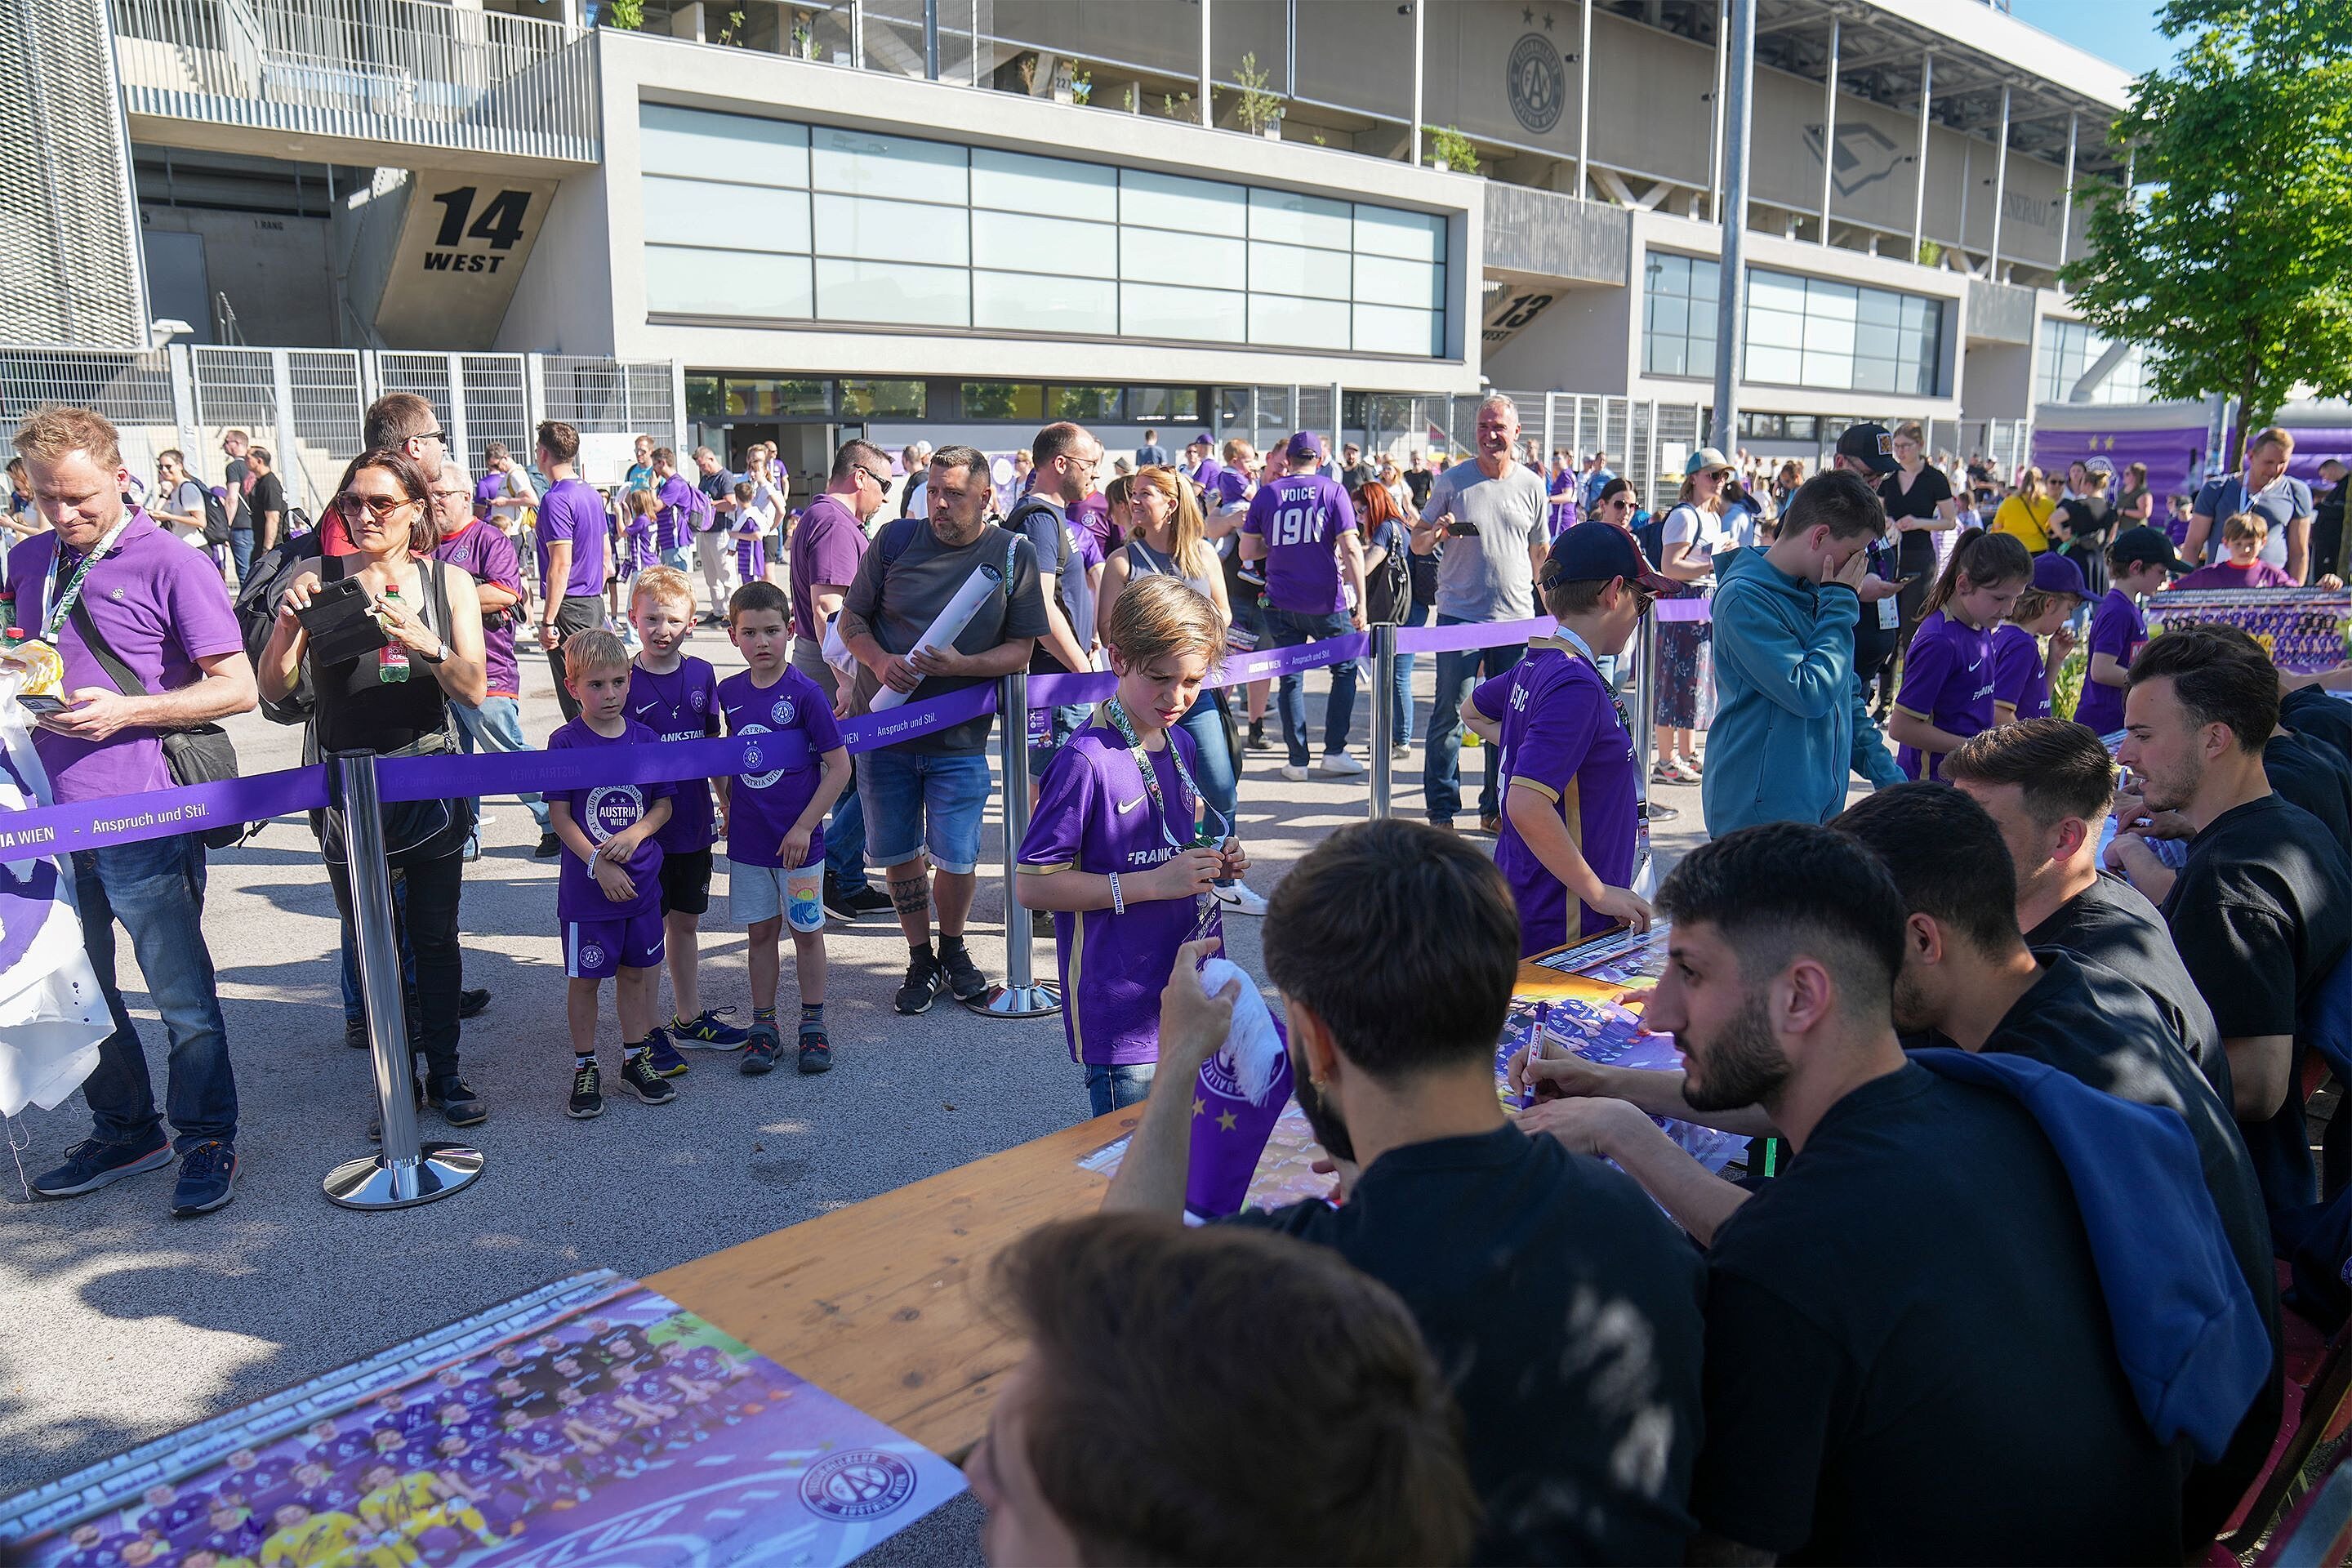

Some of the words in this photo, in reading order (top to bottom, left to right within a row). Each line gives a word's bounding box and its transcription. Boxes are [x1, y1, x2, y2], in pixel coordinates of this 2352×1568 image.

[433, 186, 532, 250] 14
[423, 252, 505, 274] WEST
[1491, 294, 1552, 328] 13
[1281, 486, 1316, 502] VOICE
[877, 720, 909, 737] Anspruch
[910, 715, 924, 728] und
[924, 712, 938, 724] Stil.
[588, 795, 597, 815] CLUB
[599, 806, 637, 818] AUSTRIA
[17, 826, 55, 845] WIEN
[92, 812, 154, 835] Anspruch
[158, 807, 181, 823] und
[185, 803, 210, 819] Stil.
[610, 817, 629, 827] WIEN
